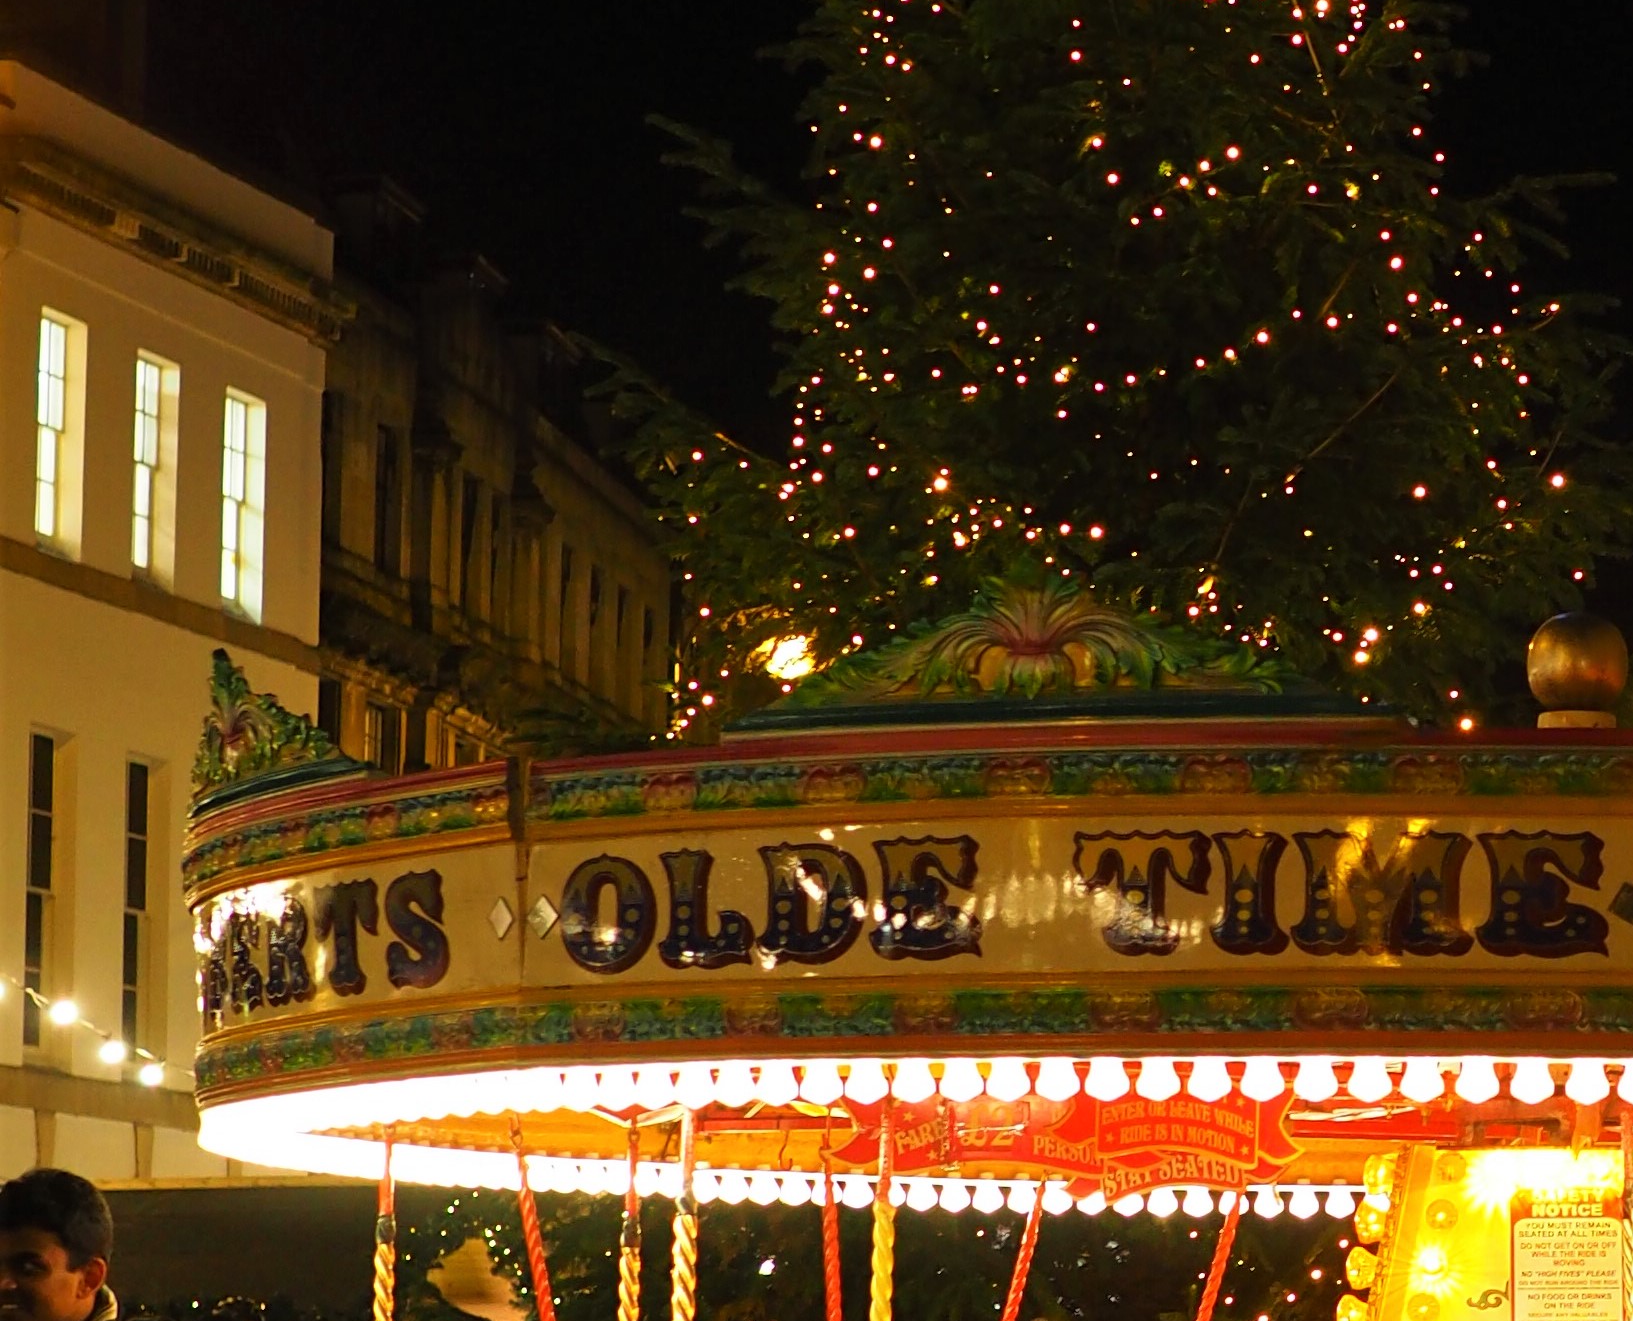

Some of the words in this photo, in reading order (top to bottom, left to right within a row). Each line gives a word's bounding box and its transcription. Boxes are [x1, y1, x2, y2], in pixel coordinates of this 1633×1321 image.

[560, 834, 983, 975] OLDE
[1073, 829, 1610, 958] TIME
[1101, 1100, 1145, 1126] ENTER
[1149, 1099, 1167, 1118] OR
[1169, 1099, 1211, 1123] LEAVE
[1214, 1106, 1256, 1139] WHILE
[1119, 1124, 1151, 1145] RIDE
[1154, 1124, 1169, 1141] IS
[1170, 1124, 1184, 1141] IN
[1186, 1126, 1236, 1155] MOTION
[1158, 1156, 1242, 1185] SEATED
[1532, 1203, 1603, 1217] NOTICE
[1519, 1230, 1554, 1238] SEATED
[1557, 1230, 1567, 1238] AT
[1520, 1242, 1532, 1250] DO
[1535, 1242, 1551, 1250] NOT
[1554, 1242, 1570, 1250] GET
[1572, 1242, 1585, 1250] ON
[1531, 1250, 1558, 1258] WHILE
[1560, 1250, 1574, 1258] THE
[1577, 1250, 1596, 1258] RIDE
[1599, 1250, 1607, 1258] IS
